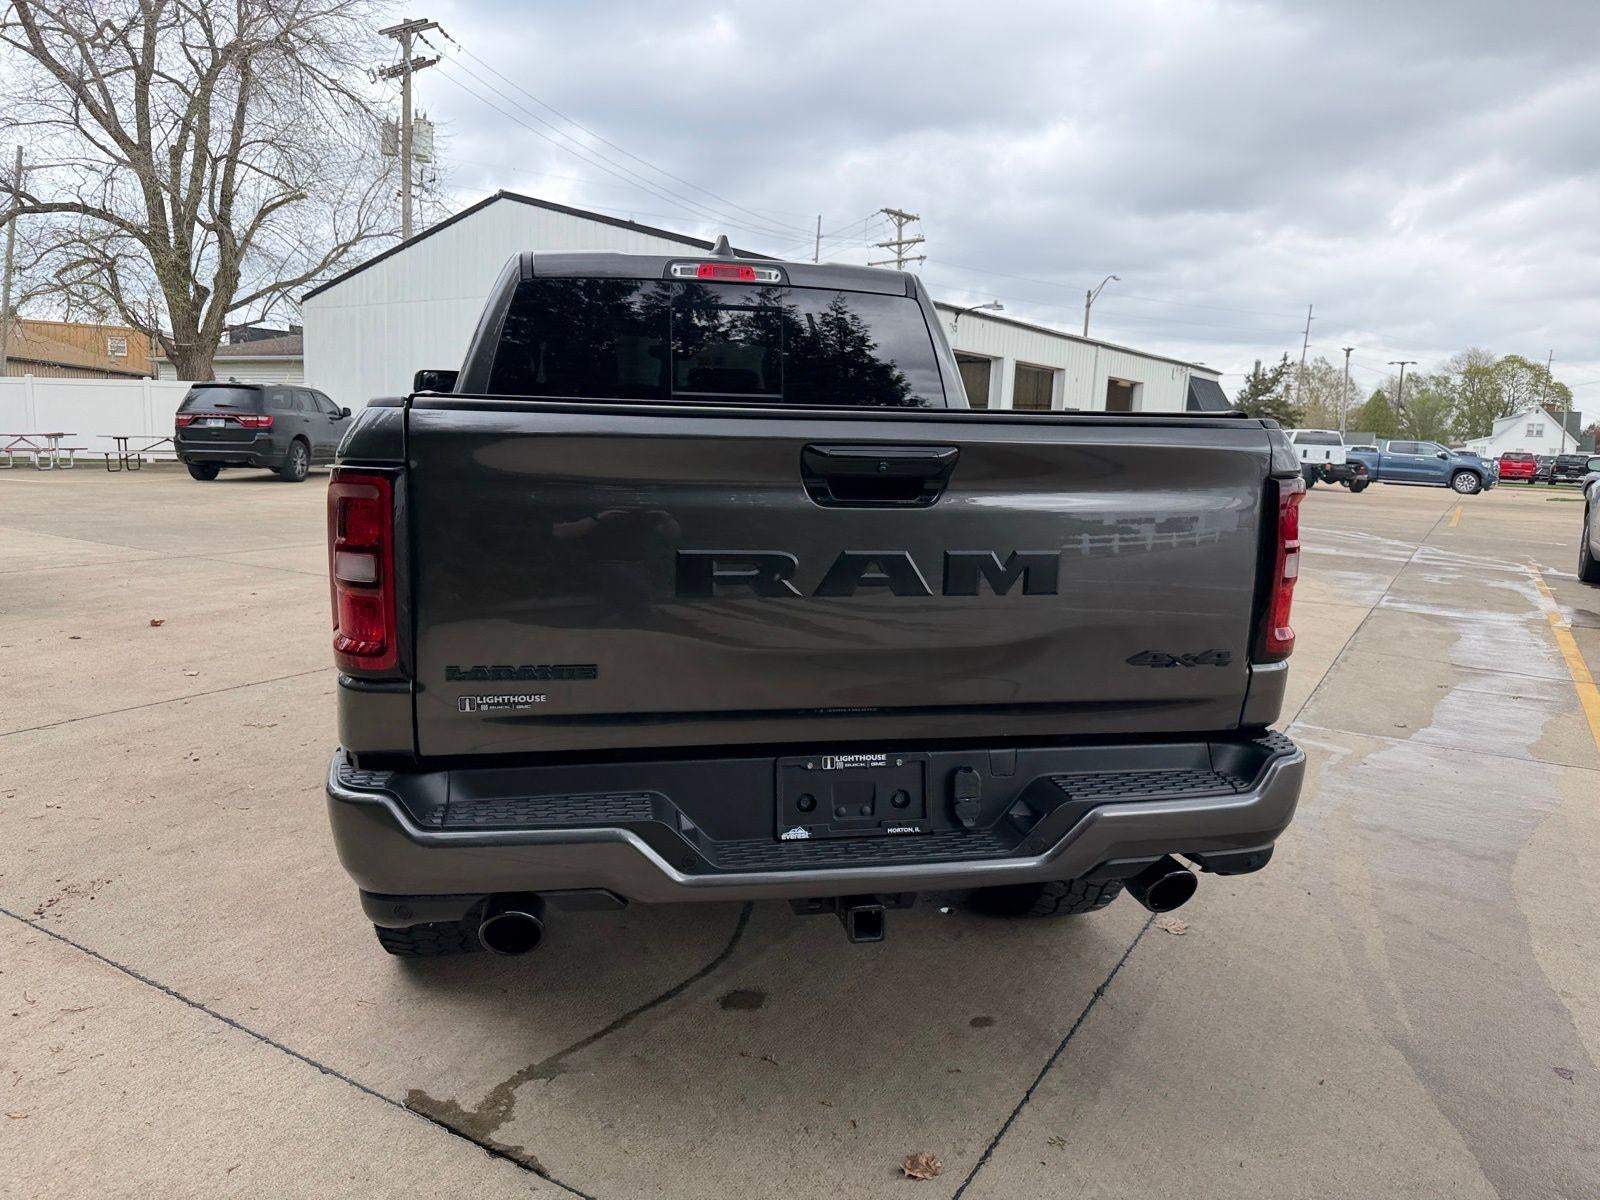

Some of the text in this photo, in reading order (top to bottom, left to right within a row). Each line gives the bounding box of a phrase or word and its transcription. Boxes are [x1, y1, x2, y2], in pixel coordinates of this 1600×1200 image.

[675, 549, 1062, 597] RAM
[477, 695, 547, 704] LIGHTHOUSE
[835, 754, 887, 762] LIGHTHOUSE
